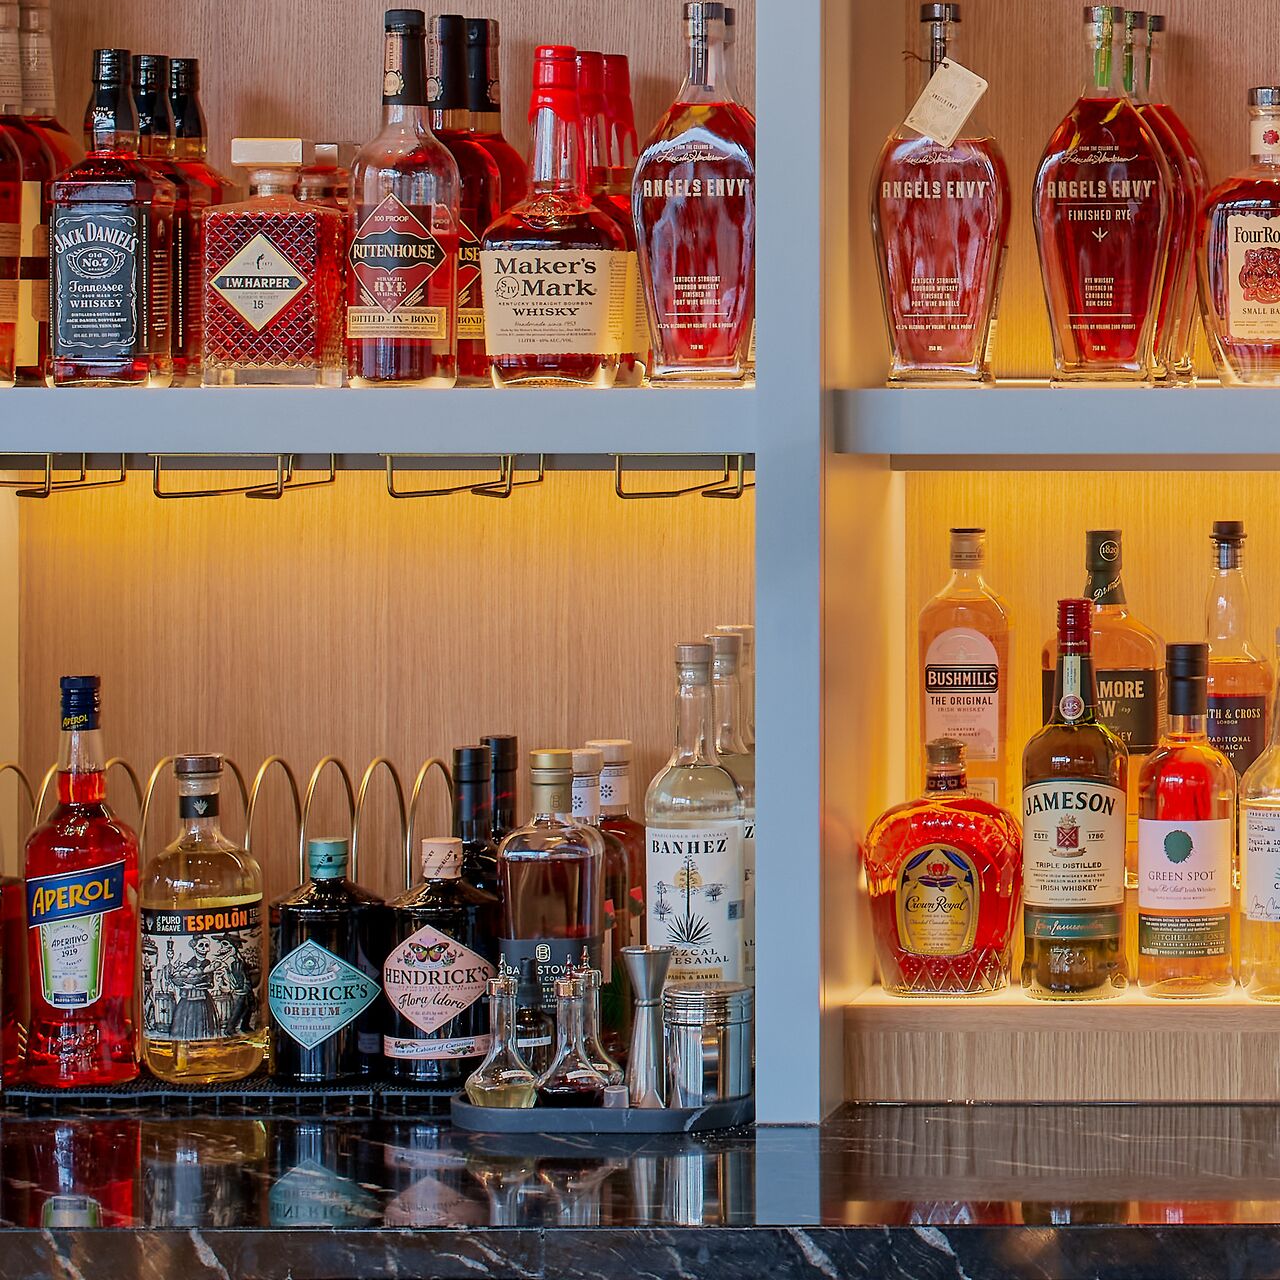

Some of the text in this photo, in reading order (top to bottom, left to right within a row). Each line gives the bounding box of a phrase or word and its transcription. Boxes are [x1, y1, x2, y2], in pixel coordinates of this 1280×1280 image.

[707, 179, 745, 197] ENVY
[947, 181, 986, 198] ENVY
[1113, 181, 1151, 198] ENVY
[1068, 209, 1131, 221] FINISHED RYE
[55, 222, 139, 254] JACK DANIEL'S
[353, 242, 435, 260] RITTENHOUSE
[494, 257, 596, 275] Maker's
[69, 280, 123, 293] Tennessee
[374, 282, 407, 293] RYE
[521, 279, 592, 297] Mark
[70, 299, 122, 308] WHISKEY
[252, 300, 264, 309] 15
[512, 307, 580, 316] WHISKY
[1242, 307, 1268, 315] SMALL
[928, 671, 996, 686] BUSHMILLS
[931, 696, 993, 705] THE ORIGINAL
[62, 714, 88, 728] APEROL
[1026, 791, 1116, 817] JAMESON
[652, 839, 728, 854] BANHEZ
[1036, 861, 1102, 869] TRIPLE DISTILLED
[1148, 871, 1215, 882] GREEN SPOT
[32, 883, 114, 917] APEROL
[906, 896, 968, 913] Crown Royal
[162, 916, 181, 925] PURO
[162, 924, 181, 932] AGAVE
[51, 934, 89, 948] APERITIVO
[61, 948, 78, 957] 1919
[386, 966, 489, 986] HENDRICK'S
[270, 982, 369, 1001] HENDRICK'S
[398, 992, 428, 1010] Flora
[284, 1006, 341, 1017] ORBIUM
